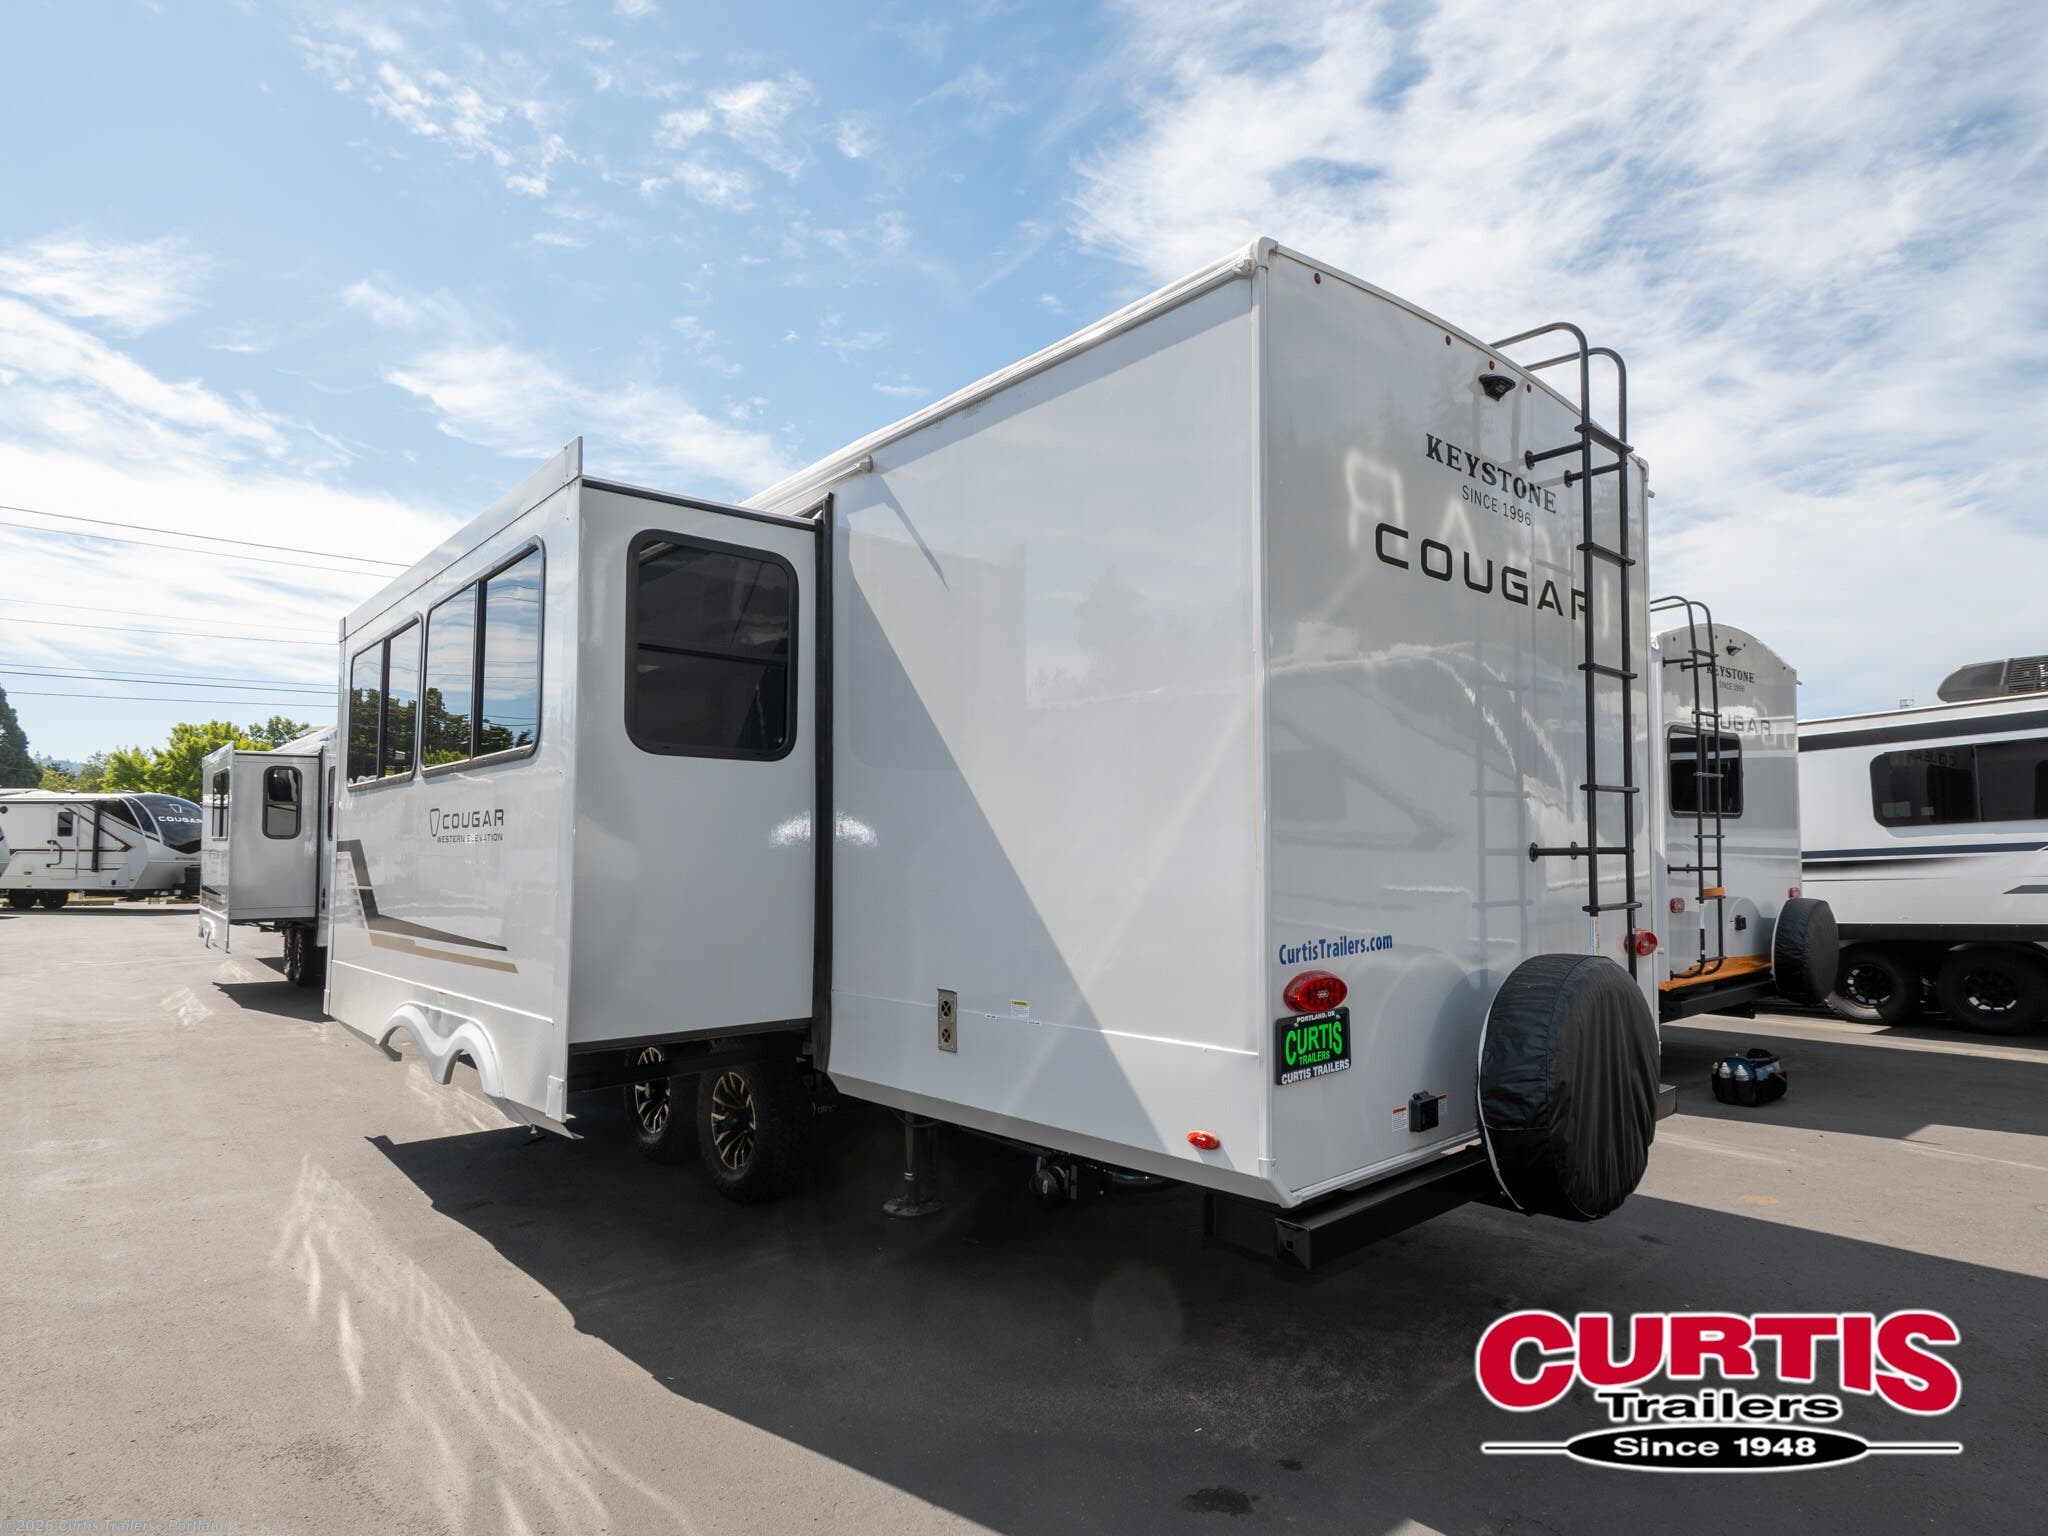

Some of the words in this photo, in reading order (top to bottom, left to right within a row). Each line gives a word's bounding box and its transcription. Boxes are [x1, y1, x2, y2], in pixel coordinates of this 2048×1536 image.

[1425, 433, 1557, 514] KEYSTONE
[1462, 485, 1498, 513] SINCE
[1503, 503, 1532, 526] 1996
[442, 808, 504, 829] COUGAR
[437, 835, 465, 843] WESTERN
[1279, 934, 1393, 965] CurtisTrailers.com
[1327, 1010, 1335, 1018] OR
[1285, 1021, 1343, 1066] CURTIS
[1298, 1050, 1331, 1066] TRAILERS
[1281, 1067, 1311, 1085] CURTIS
[1313, 1059, 1350, 1077] TRAILERS
